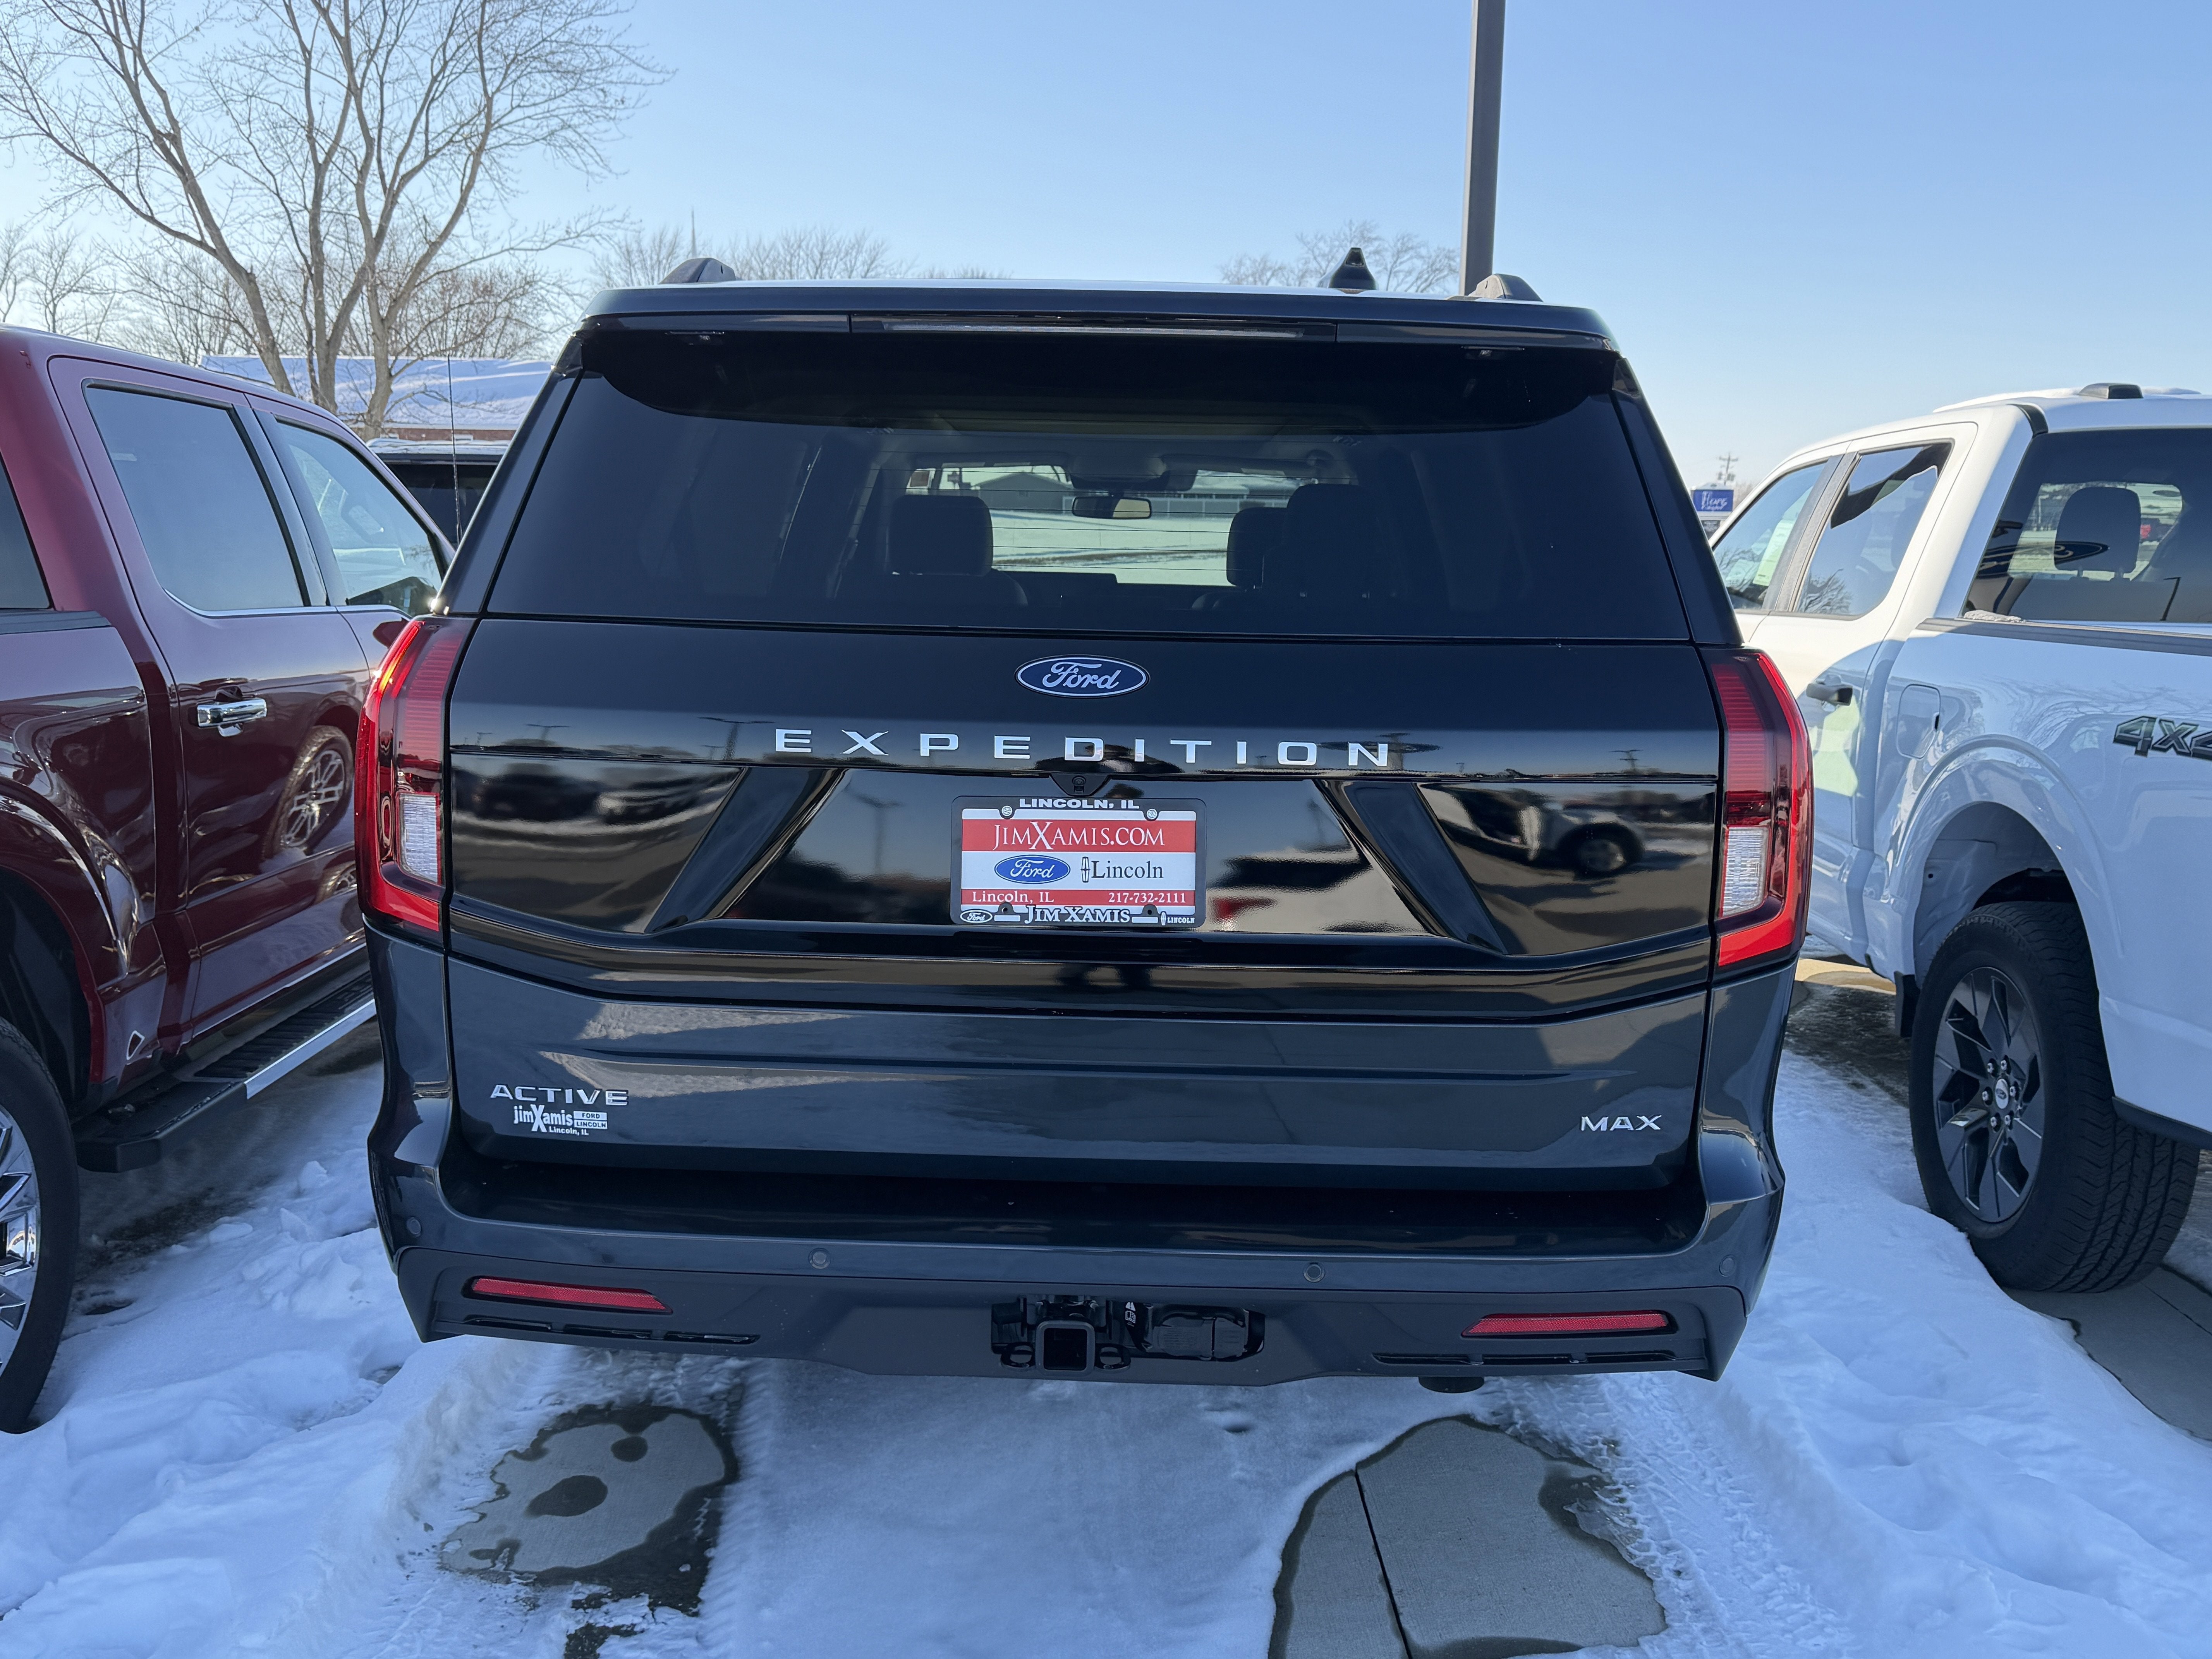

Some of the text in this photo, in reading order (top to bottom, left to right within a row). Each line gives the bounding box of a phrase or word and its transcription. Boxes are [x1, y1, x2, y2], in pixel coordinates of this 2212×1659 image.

[1042, 661, 1122, 690] Ford
[775, 728, 1388, 767] EXPEDITION
[1019, 798, 1140, 809] LINCOLN, IL
[1010, 859, 1055, 879] Ford
[1091, 860, 1164, 879] Lincoln
[972, 891, 1054, 904] Lincoln, IL
[1108, 892, 1186, 903] 217-732-2111
[1024, 905, 1130, 924] JIM XAMIS
[490, 1084, 629, 1106] ACTIVE
[549, 1126, 580, 1136] Lincoln,
[1580, 1115, 1662, 1131] MAX
